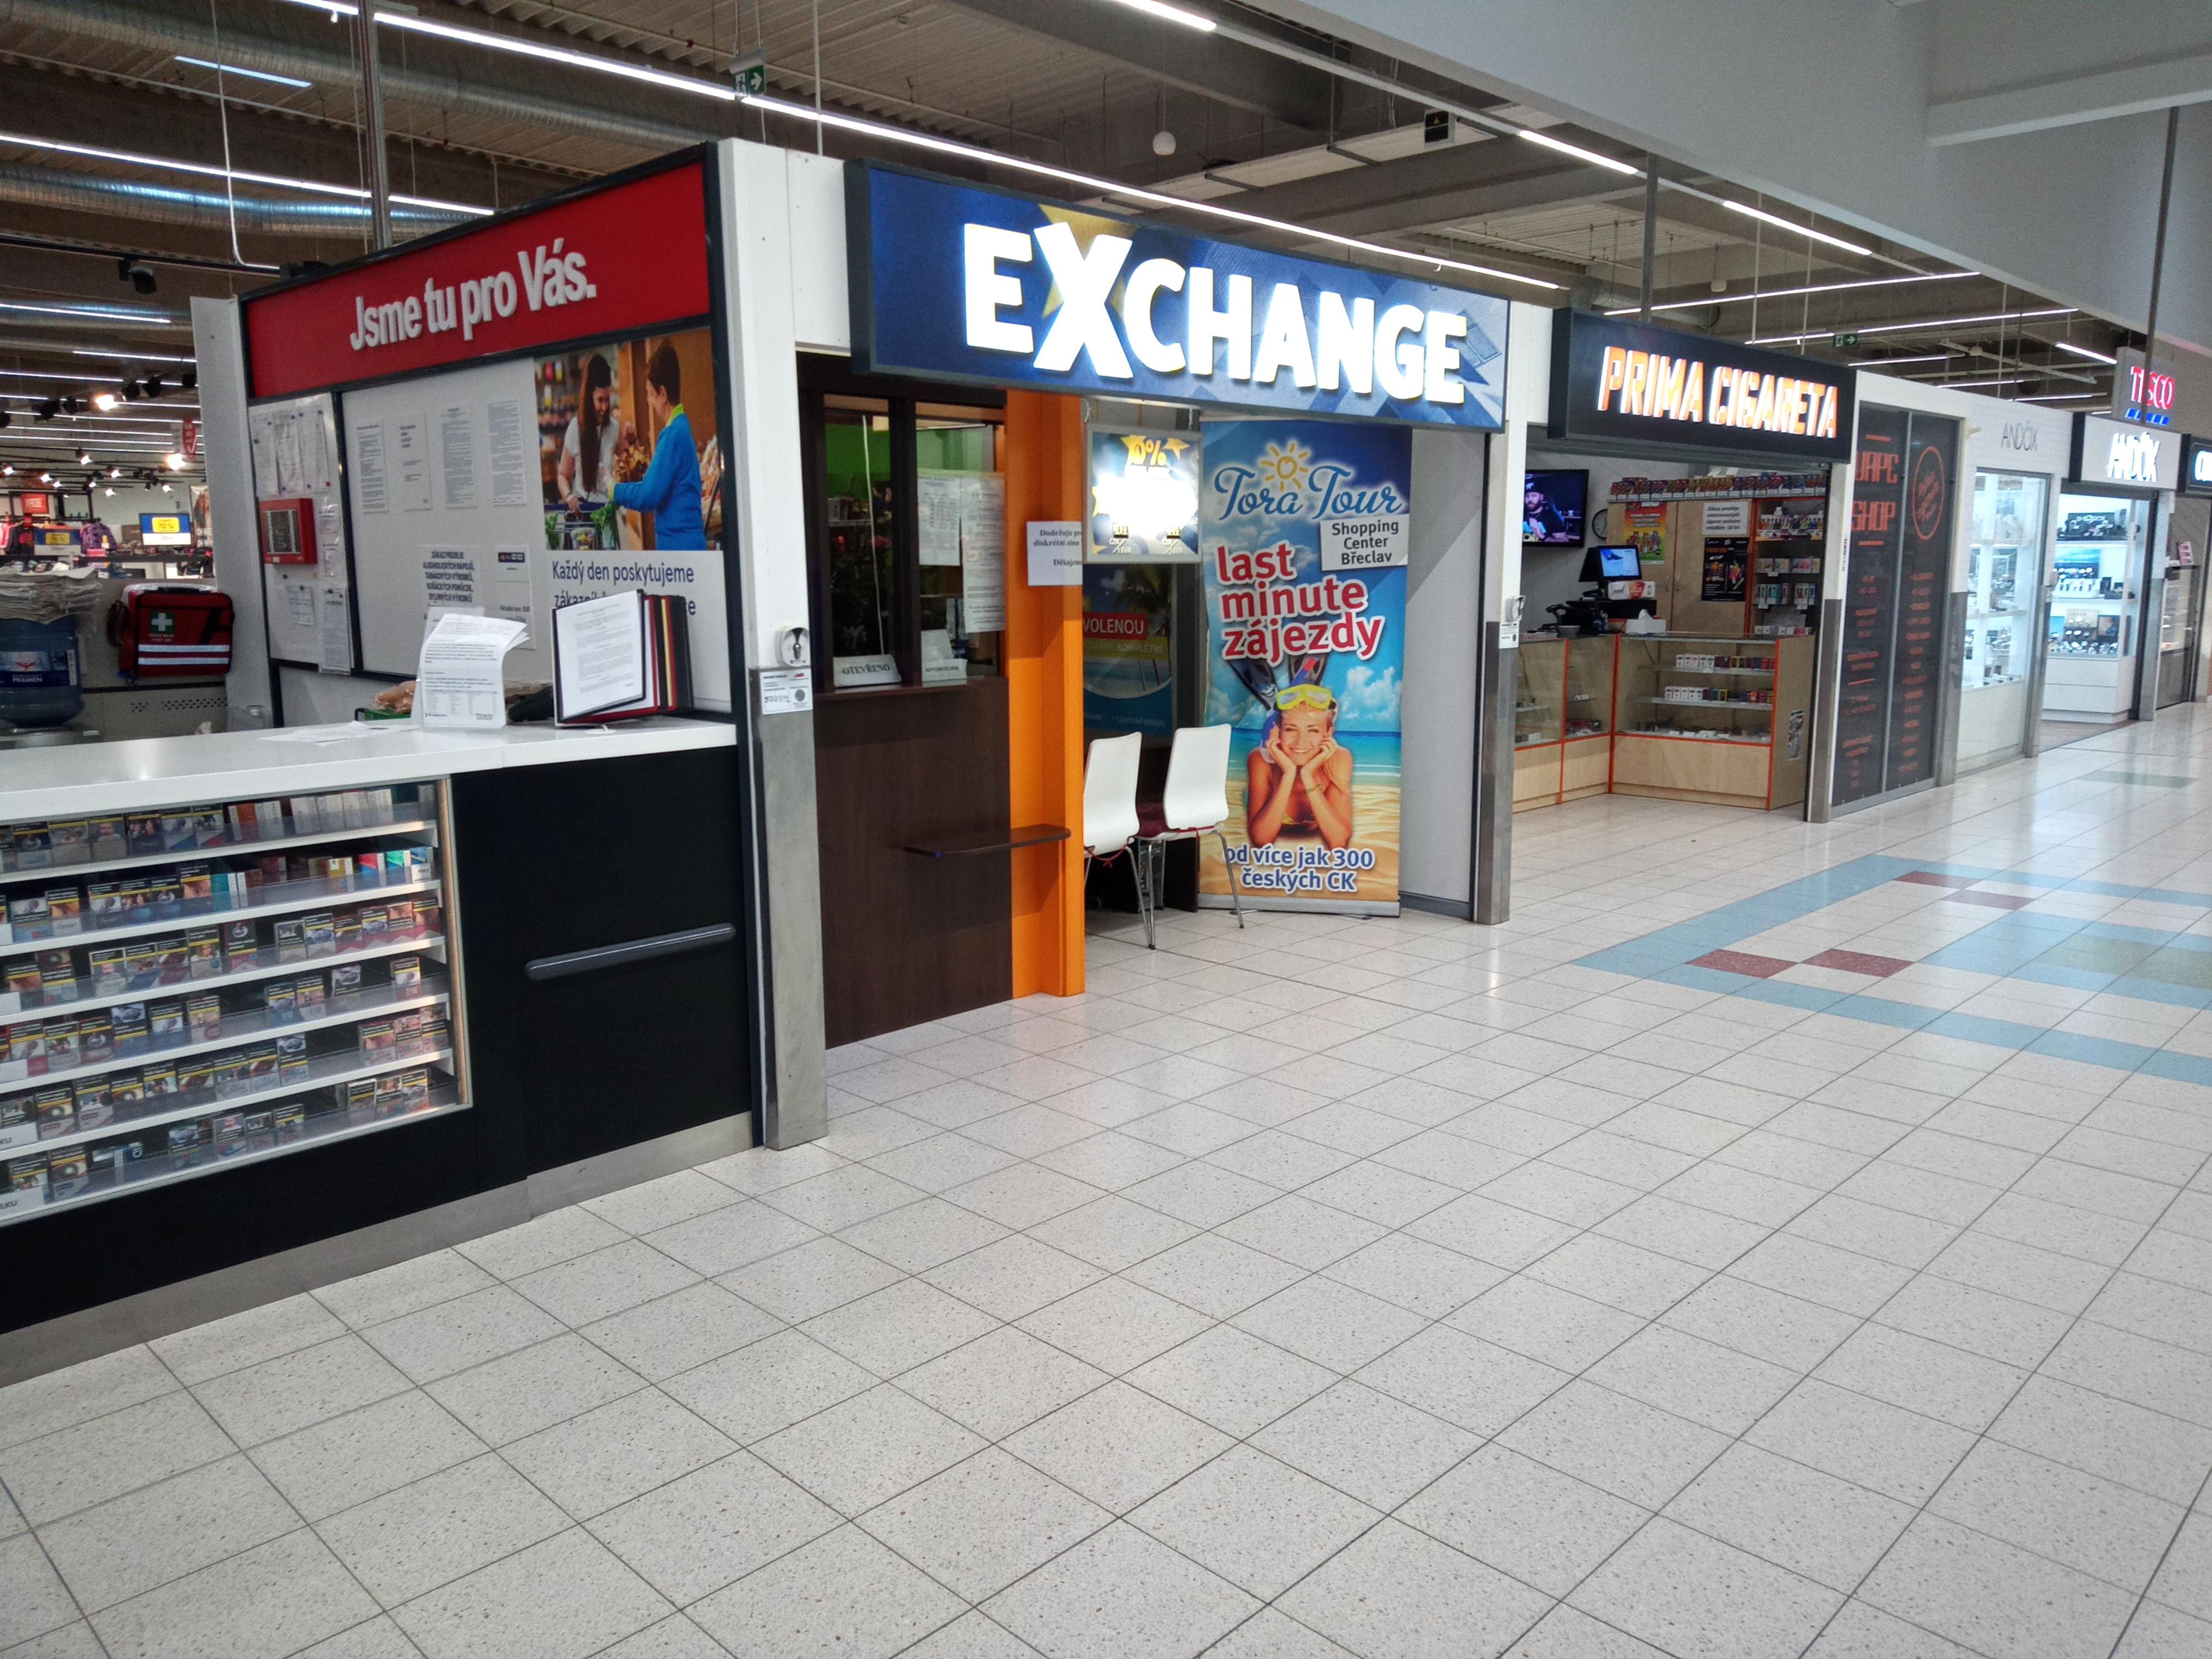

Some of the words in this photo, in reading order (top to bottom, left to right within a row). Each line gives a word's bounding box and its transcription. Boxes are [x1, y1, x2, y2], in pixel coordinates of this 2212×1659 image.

[350, 296, 422, 351] Jsme
[424, 277, 457, 333] tu
[460, 271, 518, 341] pro
[517, 237, 597, 311] Vás.
[964, 222, 1468, 404] EXCHANGE
[1597, 346, 1704, 422] PRIMA
[1708, 366, 1838, 439] CIGARETA
[1214, 467, 1303, 520] Tora
[1308, 466, 1403, 519] Tour
[1331, 519, 1399, 538] Shopping
[1851, 500, 1897, 531] SHOP
[1341, 551, 1392, 566] Břeclav
[1344, 536, 1389, 550] Center
[552, 560, 584, 585] Každý
[587, 561, 609, 581] den
[613, 562, 695, 587] poskytujeme
[1217, 542, 1295, 582] last
[1222, 578, 1366, 620] minute
[1223, 613, 1383, 662] zájezdy
[842, 664, 891, 675] OTEVŘENO
[1254, 845, 1292, 864] více
[1298, 846, 1329, 869] jak
[1332, 849, 1373, 867] 300
[1243, 868, 1321, 891] českých
[1328, 873, 1355, 890] CK
